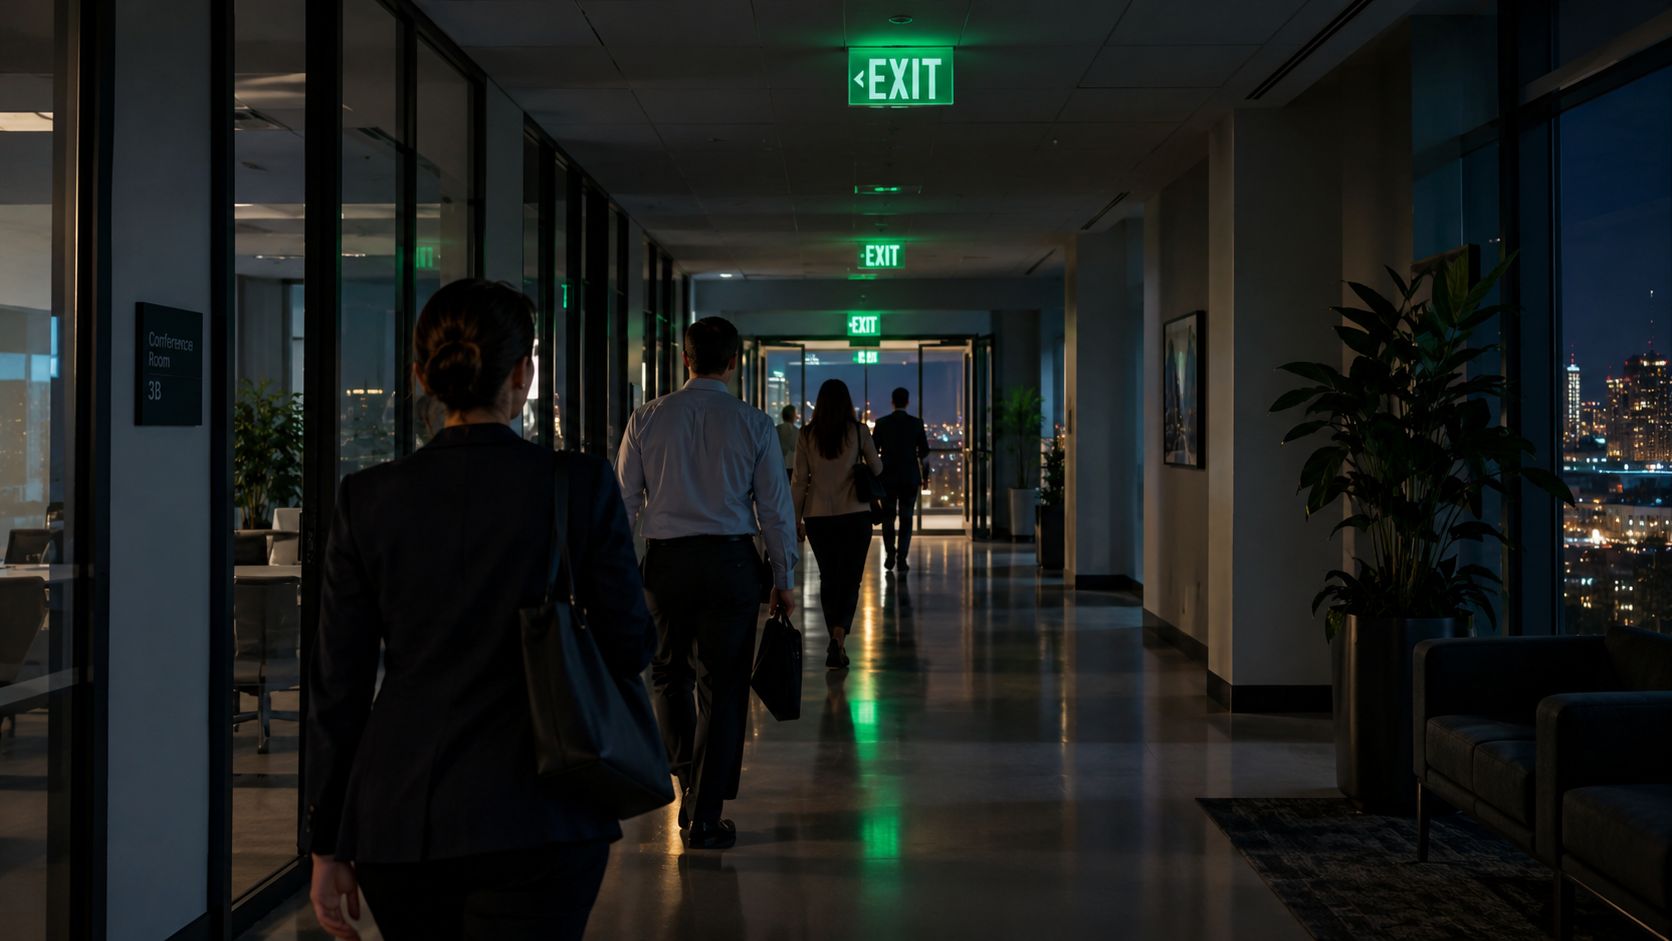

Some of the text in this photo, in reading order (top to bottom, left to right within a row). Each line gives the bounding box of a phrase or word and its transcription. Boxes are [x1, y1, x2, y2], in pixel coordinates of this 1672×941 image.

[868, 58, 942, 100] EXIT
[865, 245, 900, 267] EXIT
[851, 316, 878, 333] EXIT
[148, 331, 194, 351] Conference
[148, 351, 171, 368] Room
[147, 381, 162, 401] 3B
